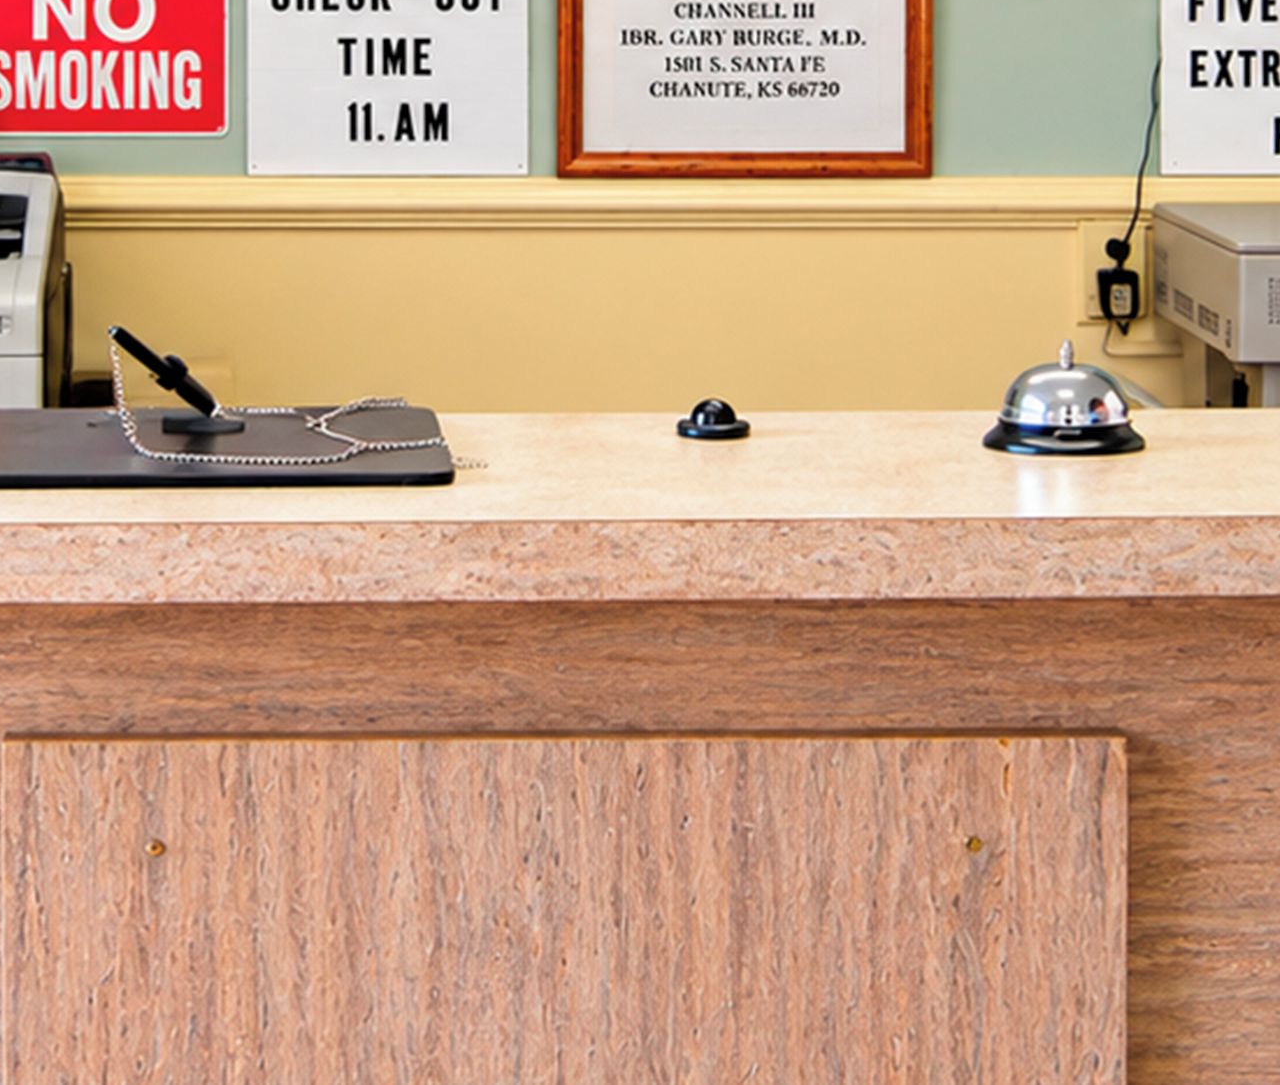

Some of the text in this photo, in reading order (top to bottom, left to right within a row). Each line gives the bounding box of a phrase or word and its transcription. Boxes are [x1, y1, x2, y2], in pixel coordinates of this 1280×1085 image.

[674, 3, 815, 19] CHANNELL III
[670, 30, 726, 45] GARY
[821, 30, 865, 45] M.D.
[338, 38, 431, 75] TIME
[666, 56, 825, 72] 1501 S. SANTA FE
[650, 81, 840, 99] CHANUTE, KS 66720
